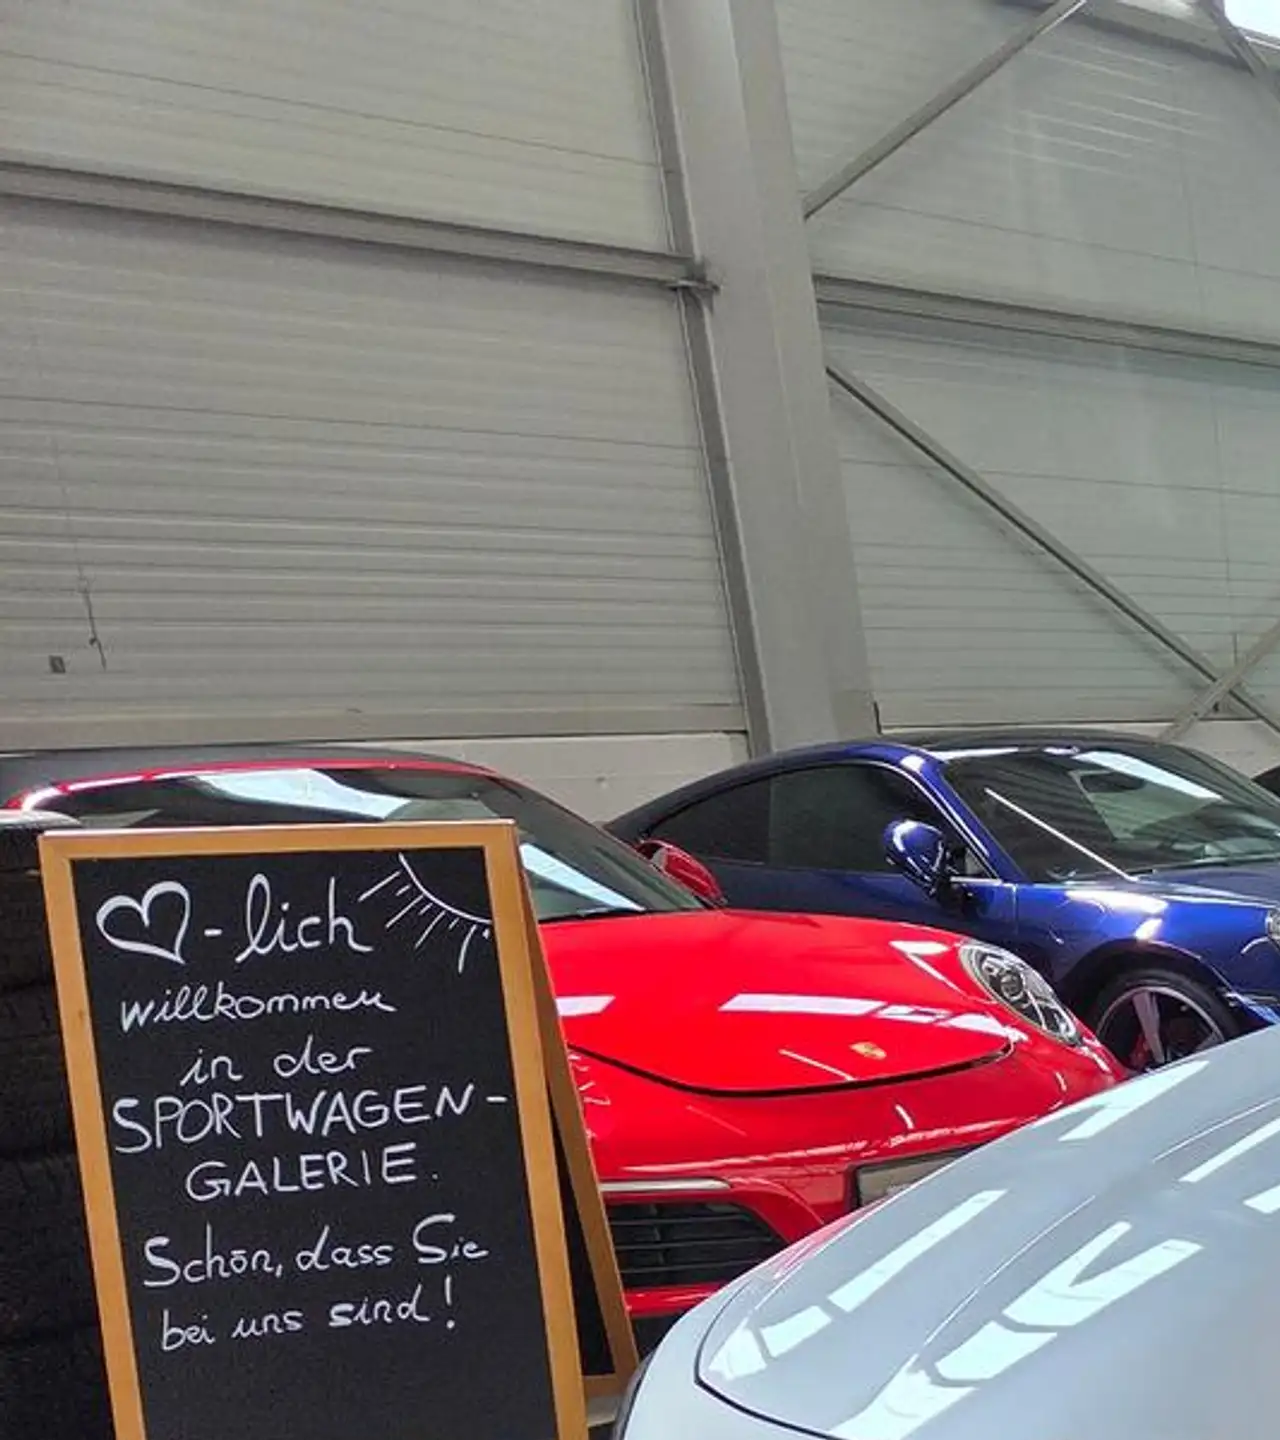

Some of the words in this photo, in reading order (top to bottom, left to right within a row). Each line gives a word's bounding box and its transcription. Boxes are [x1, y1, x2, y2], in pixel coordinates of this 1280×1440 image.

[120, 982, 396, 1031] willkommen
[179, 1049, 243, 1088] in
[273, 1034, 372, 1079] der
[112, 1083, 509, 1154] SPORTWAGEN-
[142, 1224, 283, 1288] Schön,
[296, 1226, 393, 1272] dass
[411, 1213, 489, 1262] Sie
[160, 1309, 215, 1351] bei
[230, 1308, 304, 1337] uns
